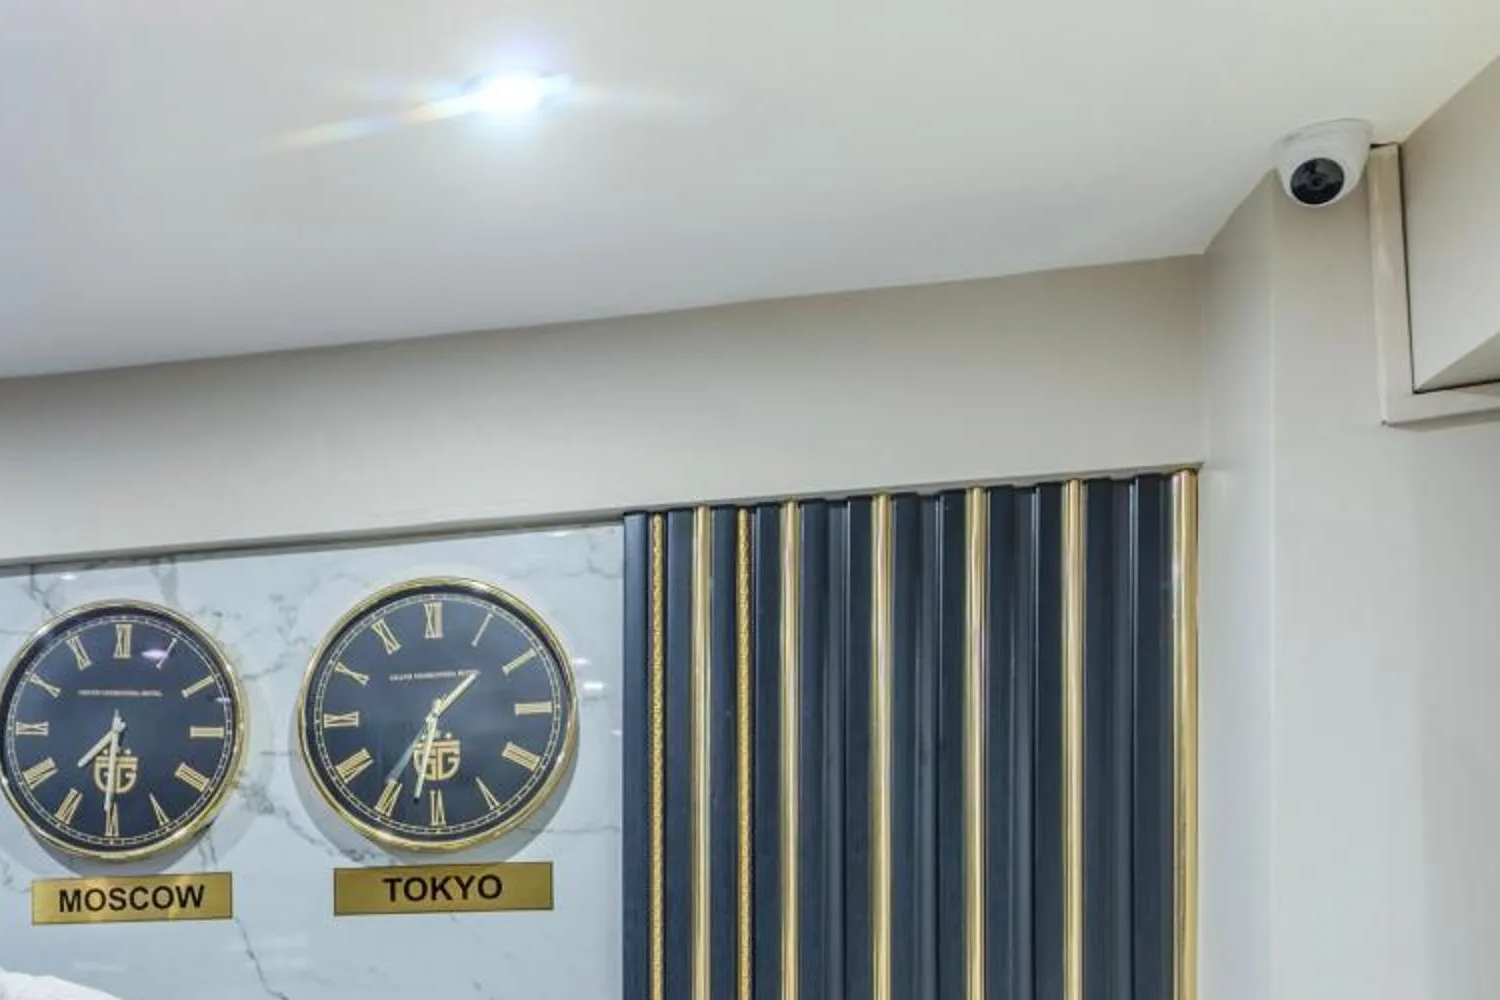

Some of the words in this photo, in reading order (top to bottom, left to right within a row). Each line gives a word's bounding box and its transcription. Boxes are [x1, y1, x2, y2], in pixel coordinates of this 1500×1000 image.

[424, 602, 443, 639] XII
[472, 613, 493, 647] I
[113, 624, 133, 658] XII
[371, 618, 401, 655] XI
[66, 635, 93, 671] XI
[155, 638, 178, 669] I
[502, 648, 537, 675] II
[27, 673, 62, 698] X
[181, 675, 216, 698] II
[335, 661, 370, 686] X
[323, 711, 359, 729] IX
[514, 702, 552, 715] III
[16, 722, 49, 735] IX
[189, 726, 225, 738] III
[430, 790, 447, 827] VI
[476, 777, 500, 811] V
[105, 803, 120, 837] VI
[149, 793, 171, 826] V
[59, 885, 205, 913] MOSCOW
[382, 874, 503, 902] TOKYO
